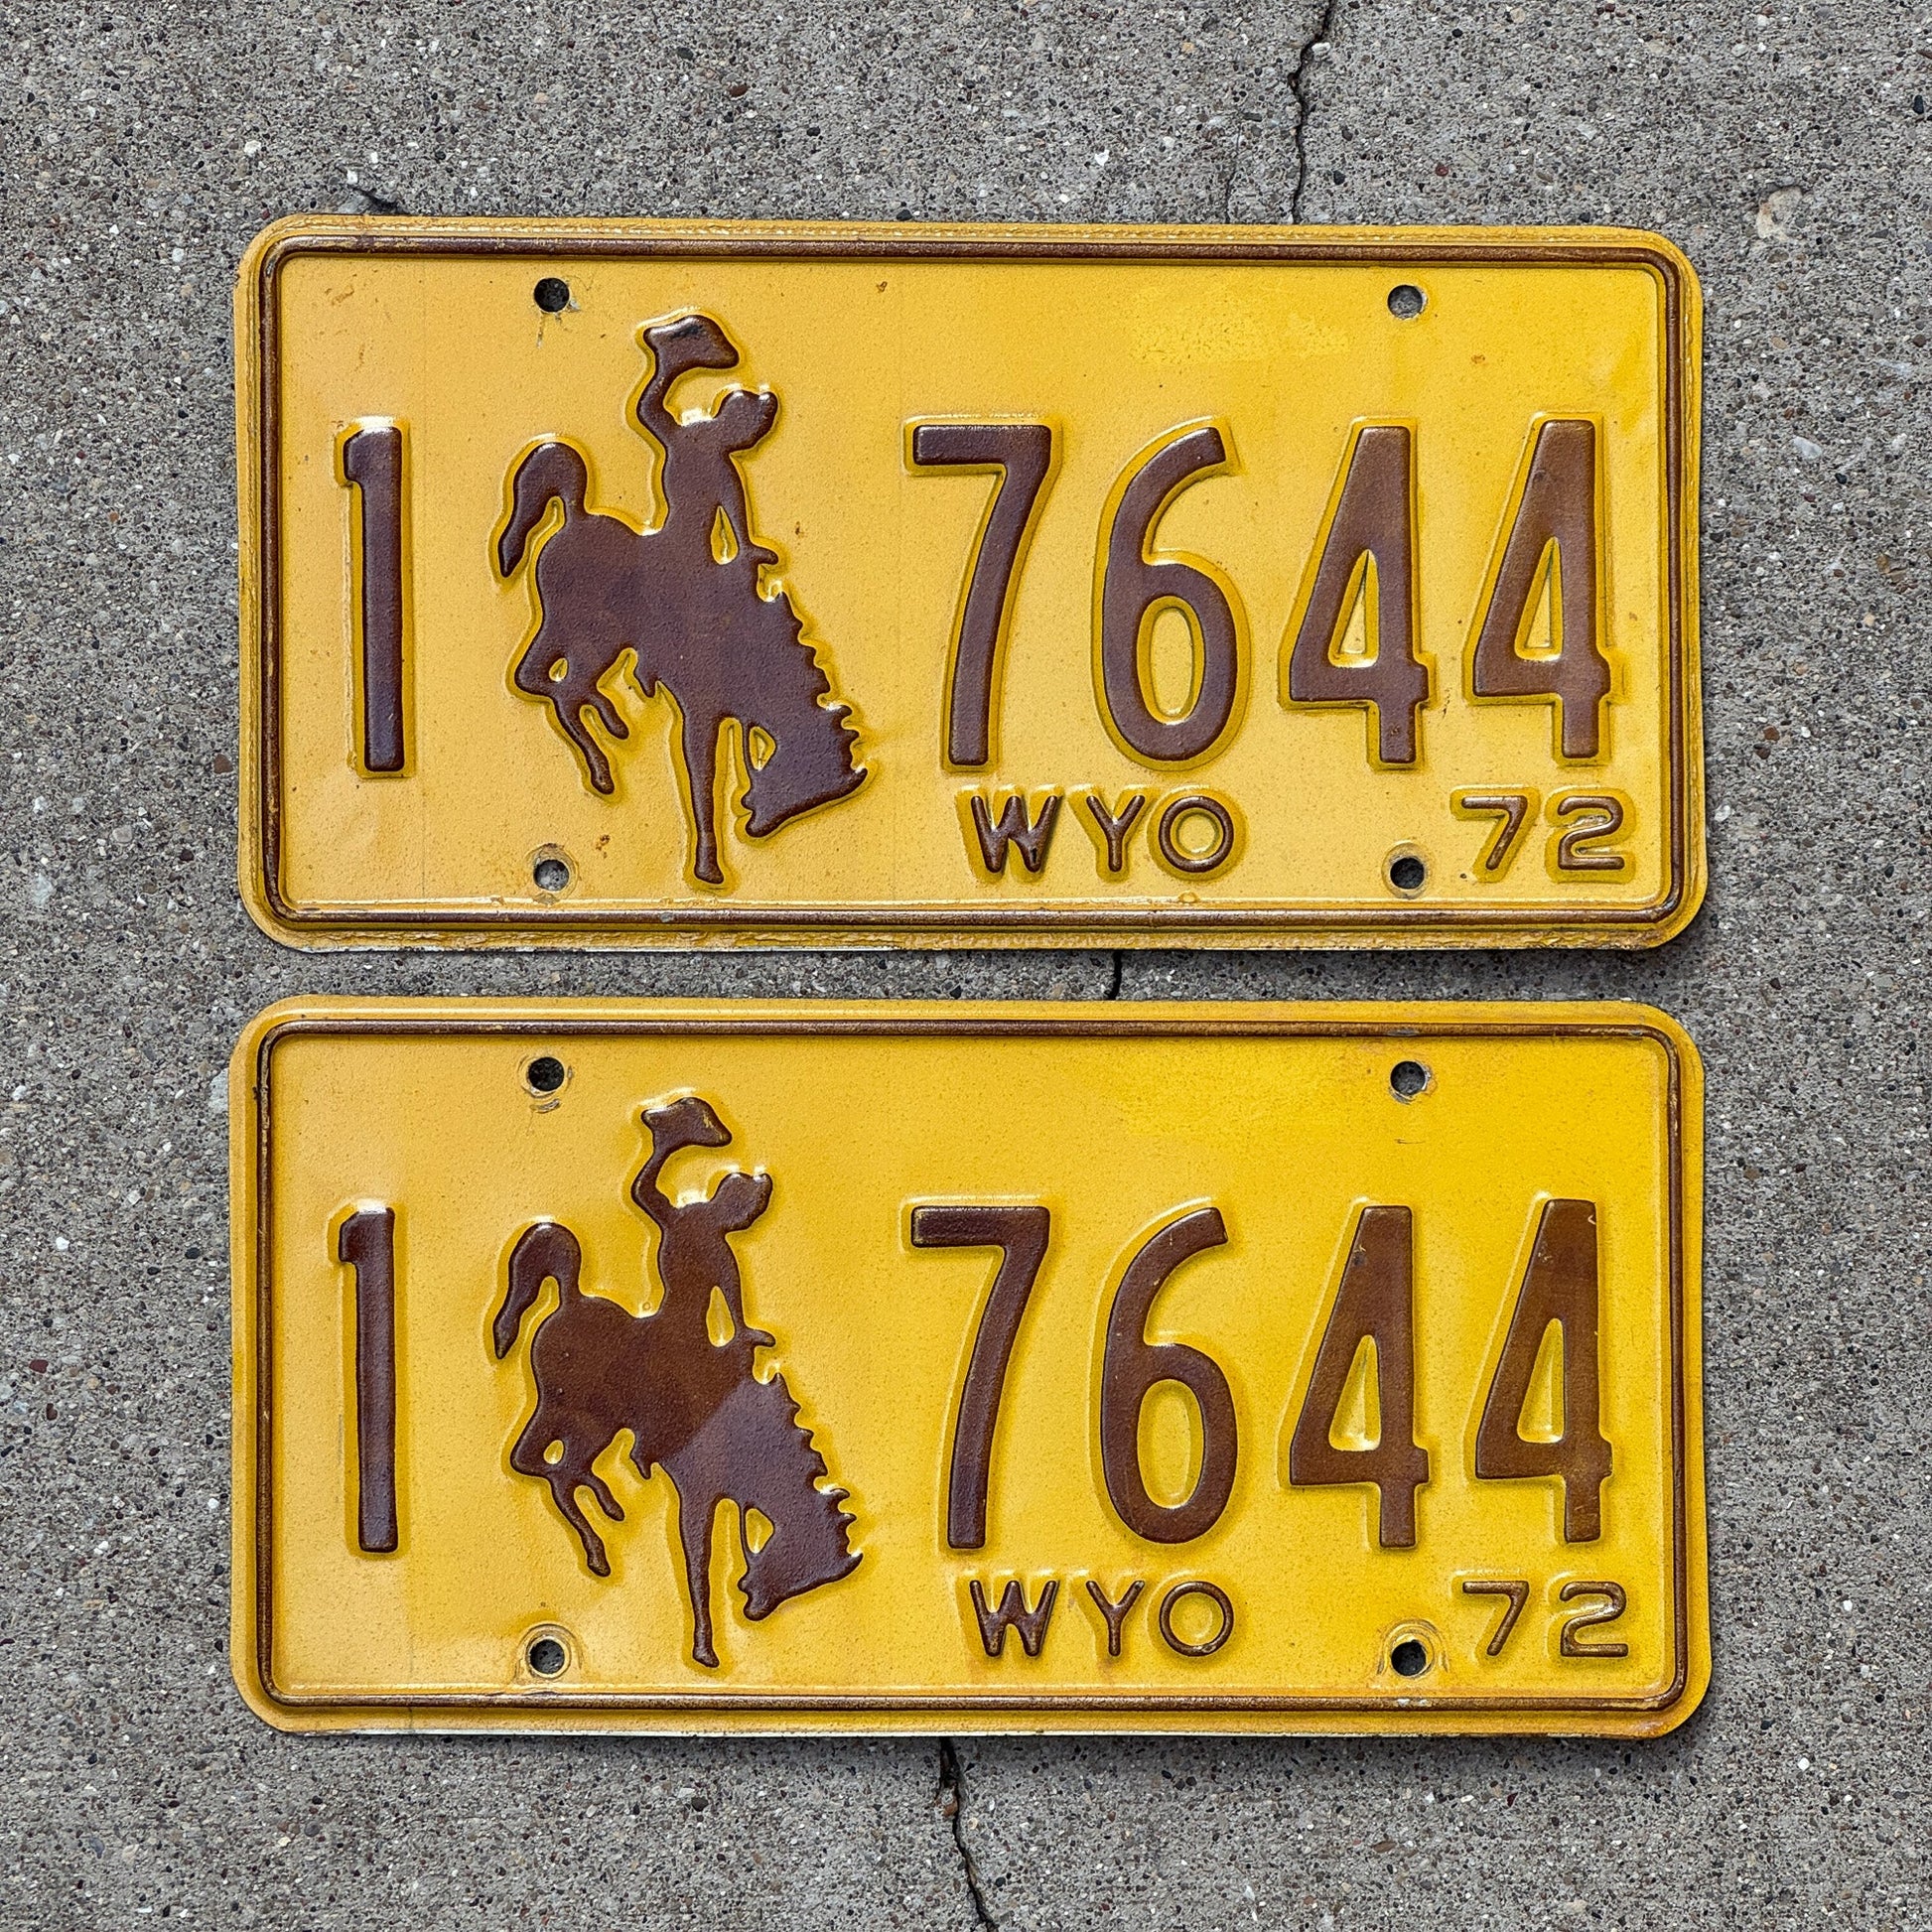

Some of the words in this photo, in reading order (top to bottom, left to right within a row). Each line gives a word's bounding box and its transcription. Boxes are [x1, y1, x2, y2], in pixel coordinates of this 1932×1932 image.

[342, 425, 405, 773] 1
[911, 419, 1612, 767] 7644
[970, 793, 1236, 876] WYO
[1460, 795, 1626, 873] 72
[338, 1206, 399, 1558] 1
[909, 1198, 1613, 1551] 7644
[969, 1580, 1235, 1660] WYO
[1461, 1580, 1629, 1659] 72
